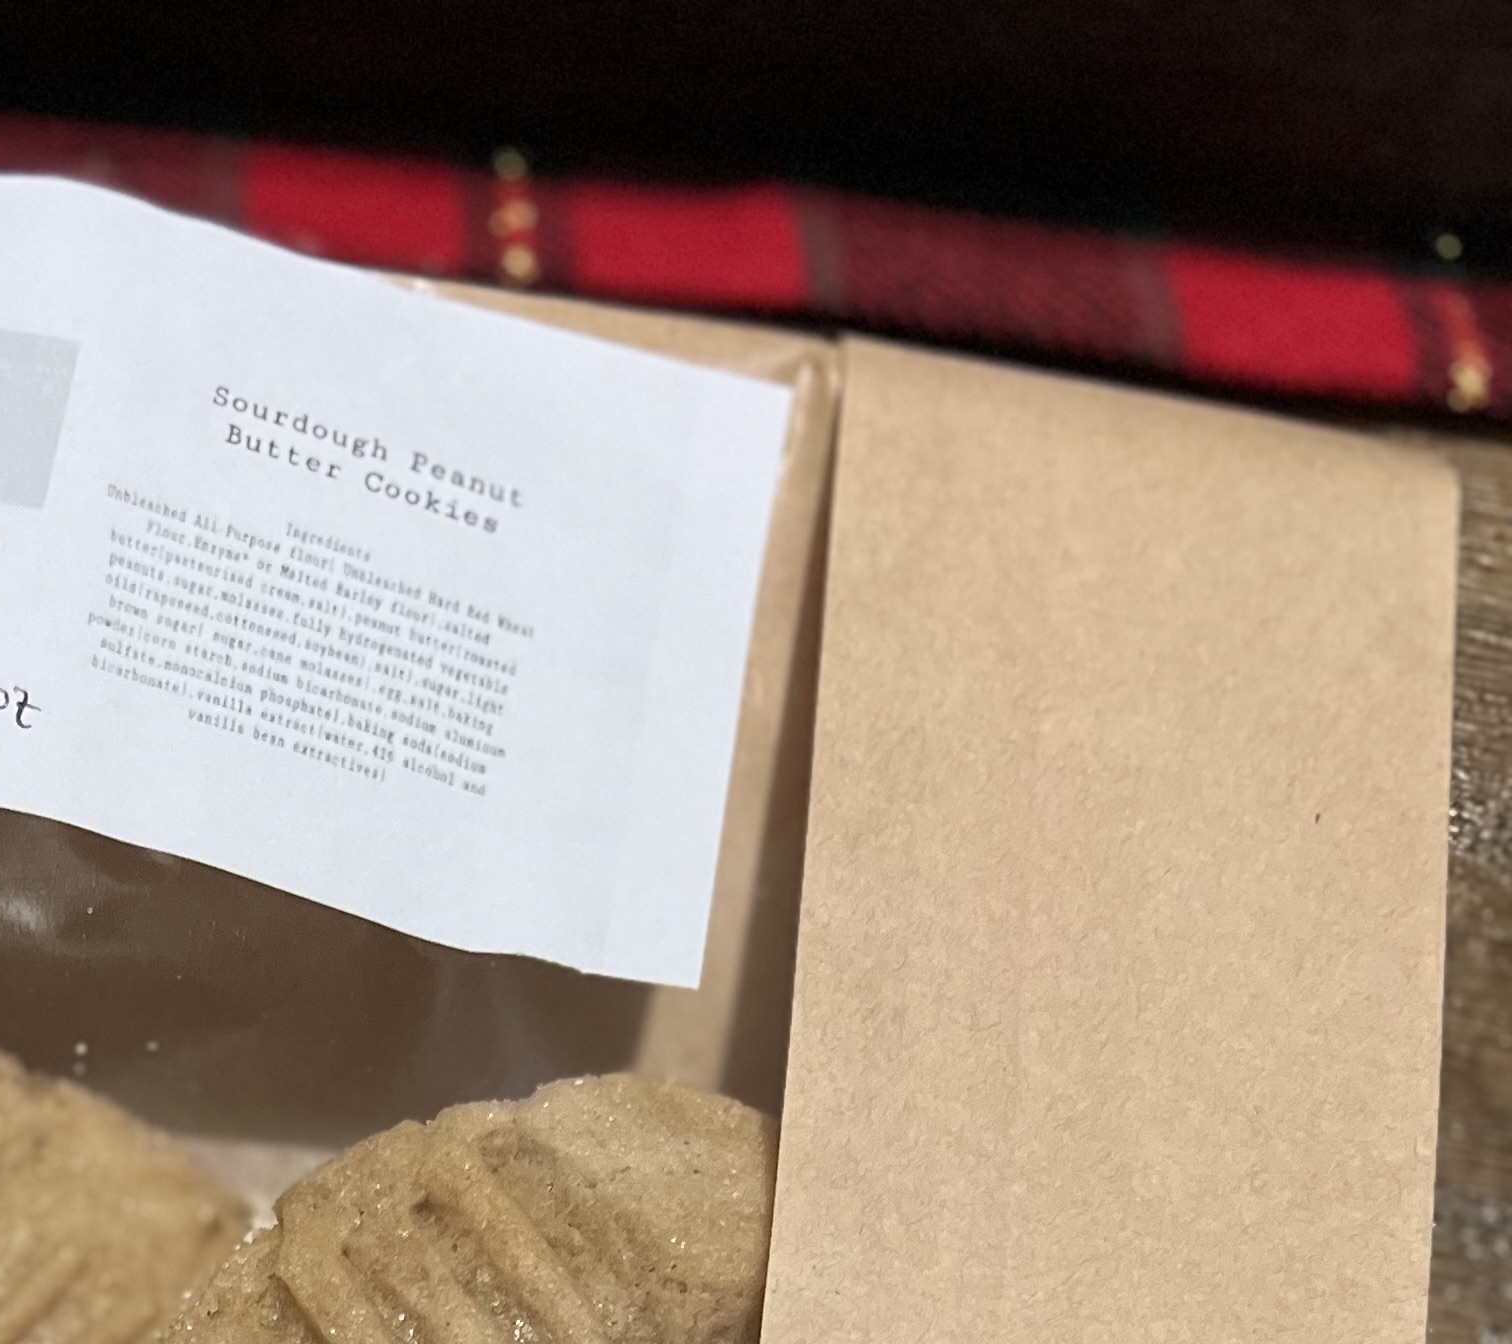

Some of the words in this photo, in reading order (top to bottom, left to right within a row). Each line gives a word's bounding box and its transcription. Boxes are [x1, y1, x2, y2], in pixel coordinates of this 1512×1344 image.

[213, 385, 388, 461] Sourdough
[410, 452, 523, 508] Peanut
[225, 424, 343, 480] Butter
[364, 472, 499, 534] Cookies
[106, 484, 187, 522] Unbleached
[341, 561, 422, 600] Unbleached
[427, 591, 460, 613] Hard
[466, 604, 490, 624] Red
[285, 522, 371, 563] Ingredients
[256, 559, 271, 573] or
[279, 564, 328, 591] Malted
[107, 593, 149, 619] brown
[187, 705, 245, 736] vanilla
[252, 726, 286, 748] bean
[463, 778, 487, 796] and
